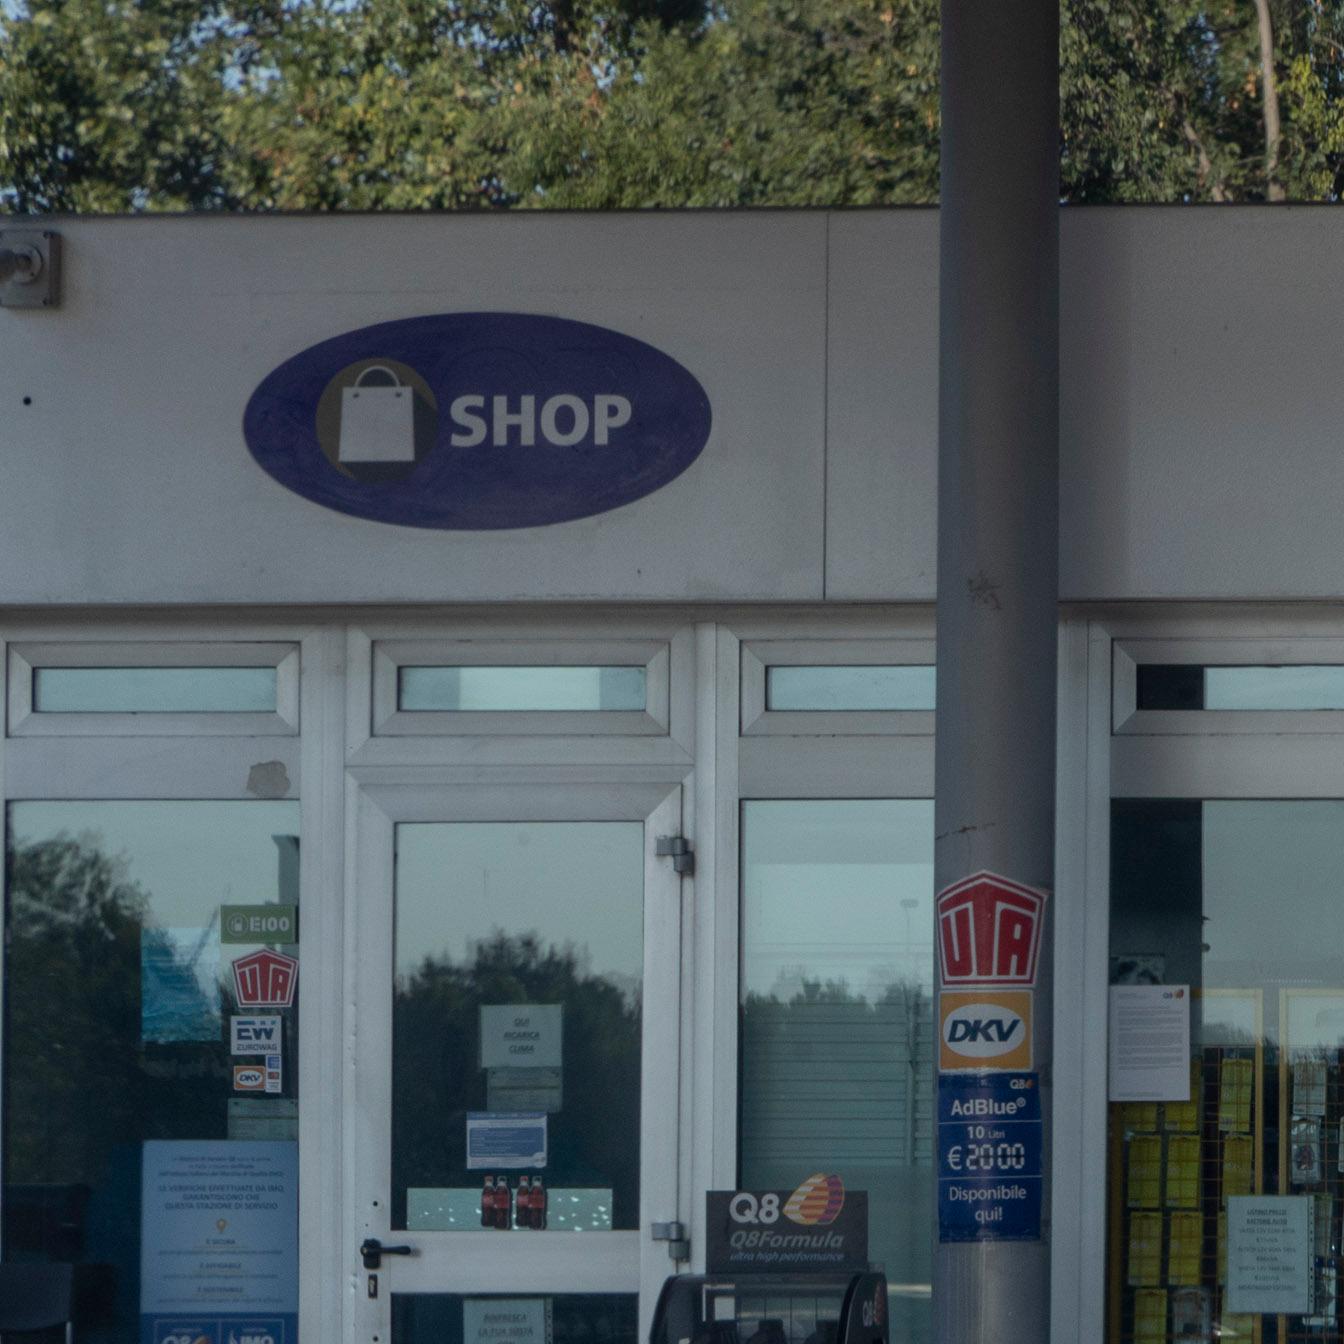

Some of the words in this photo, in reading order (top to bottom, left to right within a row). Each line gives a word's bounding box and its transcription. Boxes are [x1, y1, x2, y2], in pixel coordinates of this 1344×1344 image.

[449, 393, 633, 448] SHOP
[938, 880, 1039, 978] UTA
[237, 951, 296, 1003] UTA
[946, 1018, 1022, 1044] DKV
[966, 1126, 985, 1140] 10
[948, 1186, 1027, 1204] Disponibile
[729, 1192, 780, 1225] Q8
[974, 1206, 1004, 1225] qui!
[729, 1230, 845, 1251] Q8Formula
[730, 1251, 754, 1262] ultra
[756, 1251, 779, 1264] high
[780, 1251, 845, 1264] performance
